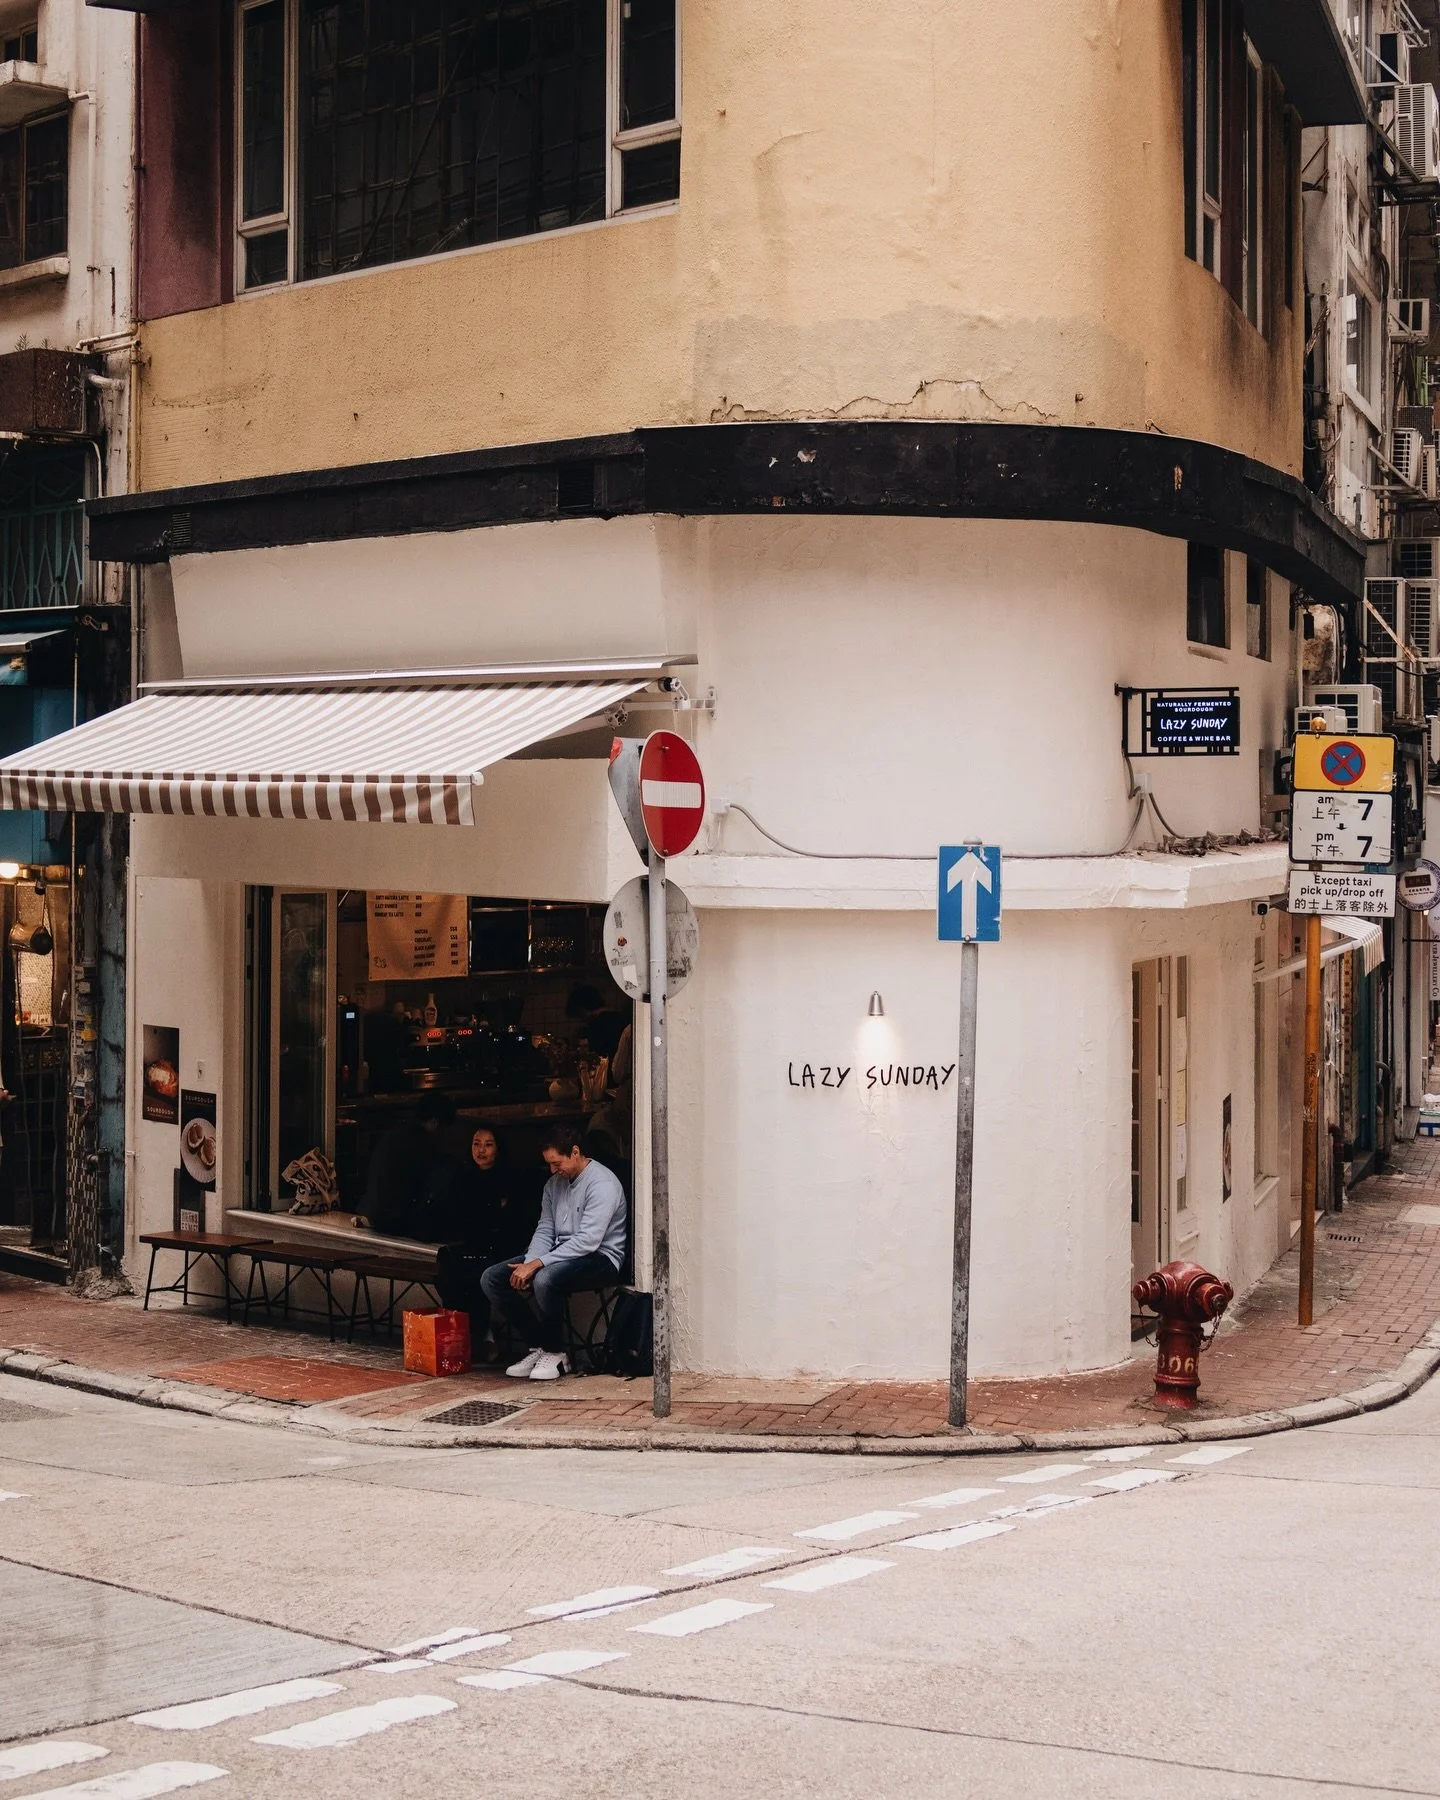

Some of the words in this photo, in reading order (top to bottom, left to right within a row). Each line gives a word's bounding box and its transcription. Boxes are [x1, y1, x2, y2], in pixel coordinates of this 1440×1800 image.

[1160, 718, 1187, 730] LAZY
[1191, 718, 1228, 730] SUNDAY
[1311, 807, 1341, 820] 上午
[1317, 796, 1335, 804] am
[1357, 799, 1374, 821] 7
[1311, 844, 1341, 857] 下午
[1316, 832, 1335, 846] pm
[1356, 836, 1373, 858] 7
[1314, 875, 1350, 887] Except
[1353, 876, 1372, 887] taxi
[1300, 886, 1322, 897] pick
[1325, 887, 1366, 898] up/drop
[1369, 889, 1384, 898] off
[1294, 898, 1389, 913] 的士上落客除外
[788, 1062, 851, 1089] LAZY
[866, 1063, 956, 1090] SUNDAY
